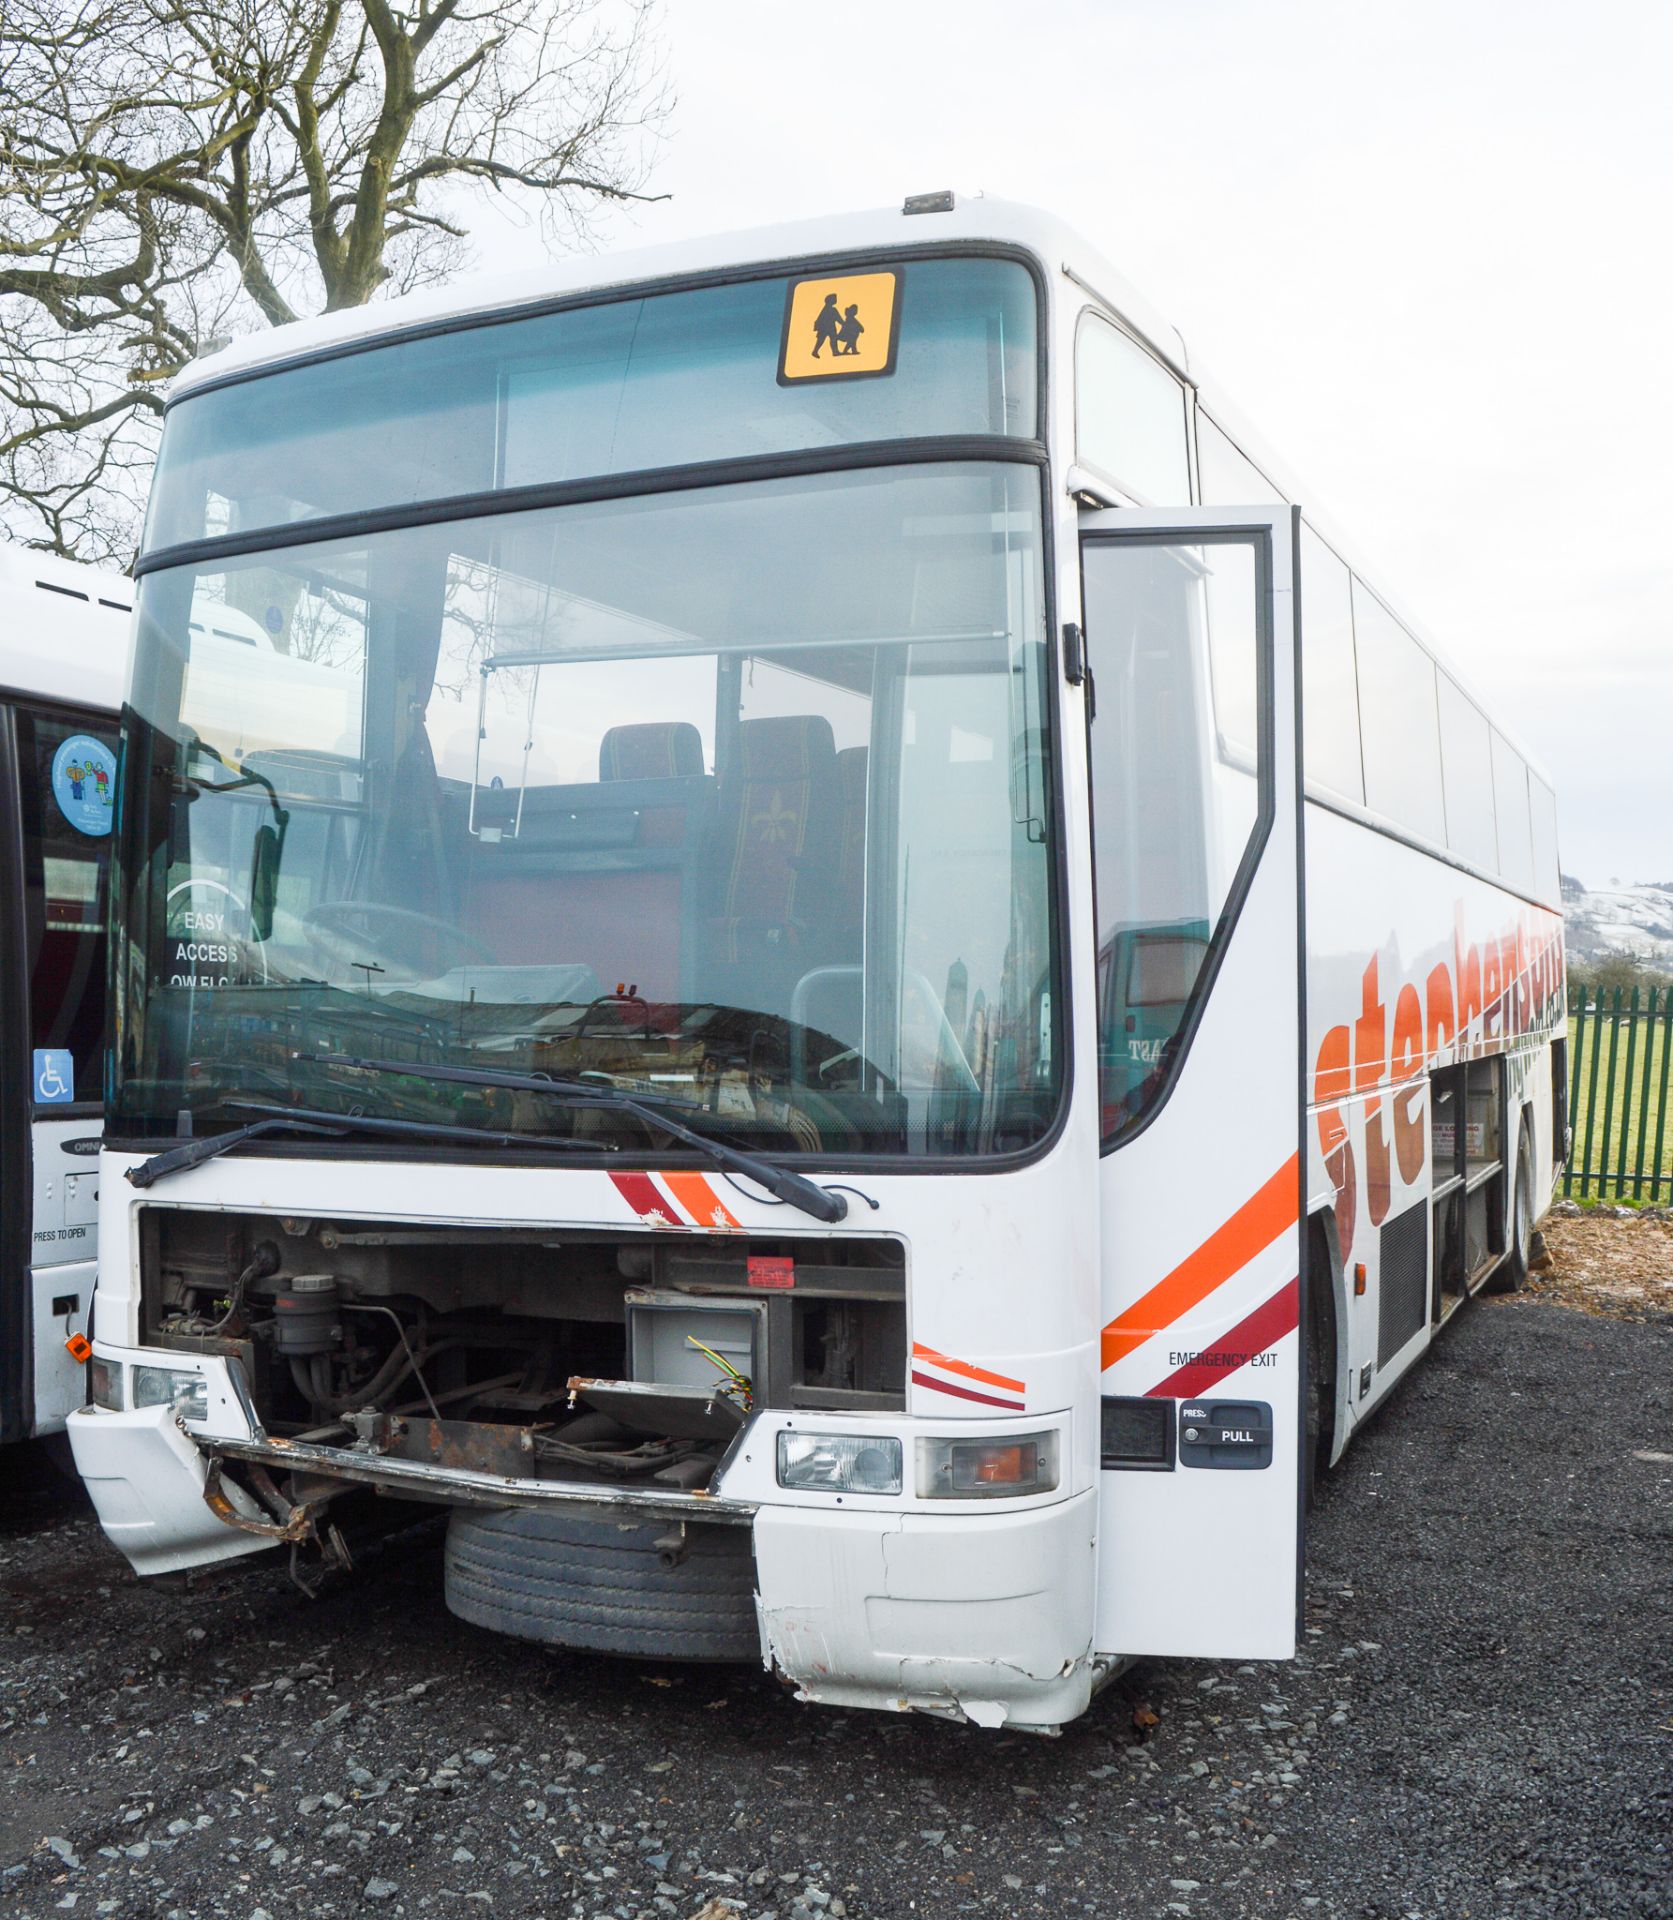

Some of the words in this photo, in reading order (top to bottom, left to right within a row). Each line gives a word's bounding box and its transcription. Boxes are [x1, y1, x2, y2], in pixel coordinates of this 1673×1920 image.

[184, 912, 225, 931] EASY
[175, 943, 238, 963] ACCESS
[170, 975, 197, 987] OW
[34, 1231, 56, 1242] PRESS
[58, 1229, 67, 1240] TO
[68, 1228, 86, 1238] OPEN
[1169, 1351, 1248, 1367] EMERGENCY
[1251, 1352, 1278, 1367] EXIT
[1222, 1430, 1254, 1442] PULL
